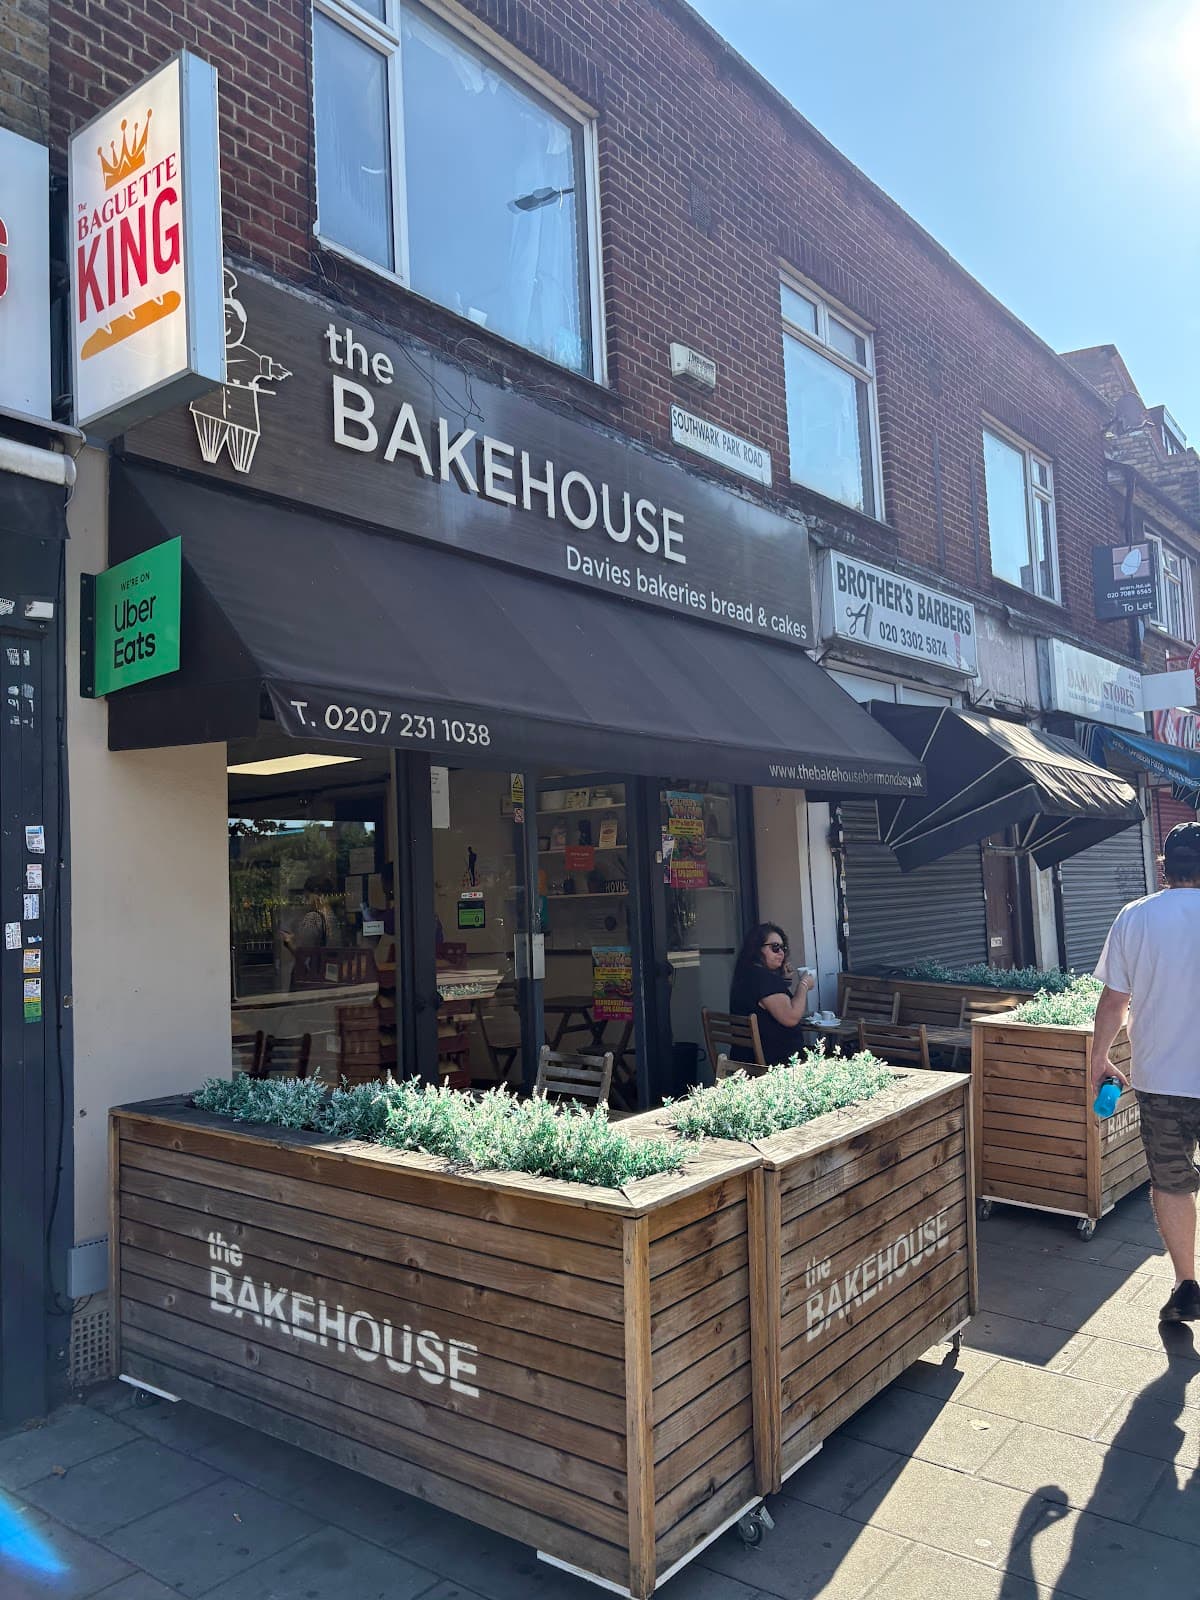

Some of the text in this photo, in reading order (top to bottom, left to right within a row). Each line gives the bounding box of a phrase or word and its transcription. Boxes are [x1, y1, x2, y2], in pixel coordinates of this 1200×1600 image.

[77, 152, 178, 242] BAGUETTE
[77, 202, 88, 214] The
[77, 186, 181, 324] KING
[325, 322, 394, 386] the
[672, 408, 764, 470] SOUTHWARK PARK ROAD
[331, 373, 688, 566] BAKEHOUSE
[120, 571, 150, 591] WE'RE ON
[565, 544, 809, 641] Davies bakeries bread & cakes
[836, 560, 973, 636] BROTHER'S BARBERS
[114, 594, 157, 633] Uber
[1121, 601, 1153, 612] To Let
[113, 632, 156, 670] Eats
[879, 621, 948, 658] 020 3302 5874
[1103, 681, 1136, 708] STORES
[290, 700, 491, 746] T. 0207 231 1038
[205, 1230, 244, 1268] the
[805, 1252, 832, 1290] the
[804, 1205, 951, 1343] BAKEHOUSE
[207, 1265, 481, 1399] BAKEHOUSE
